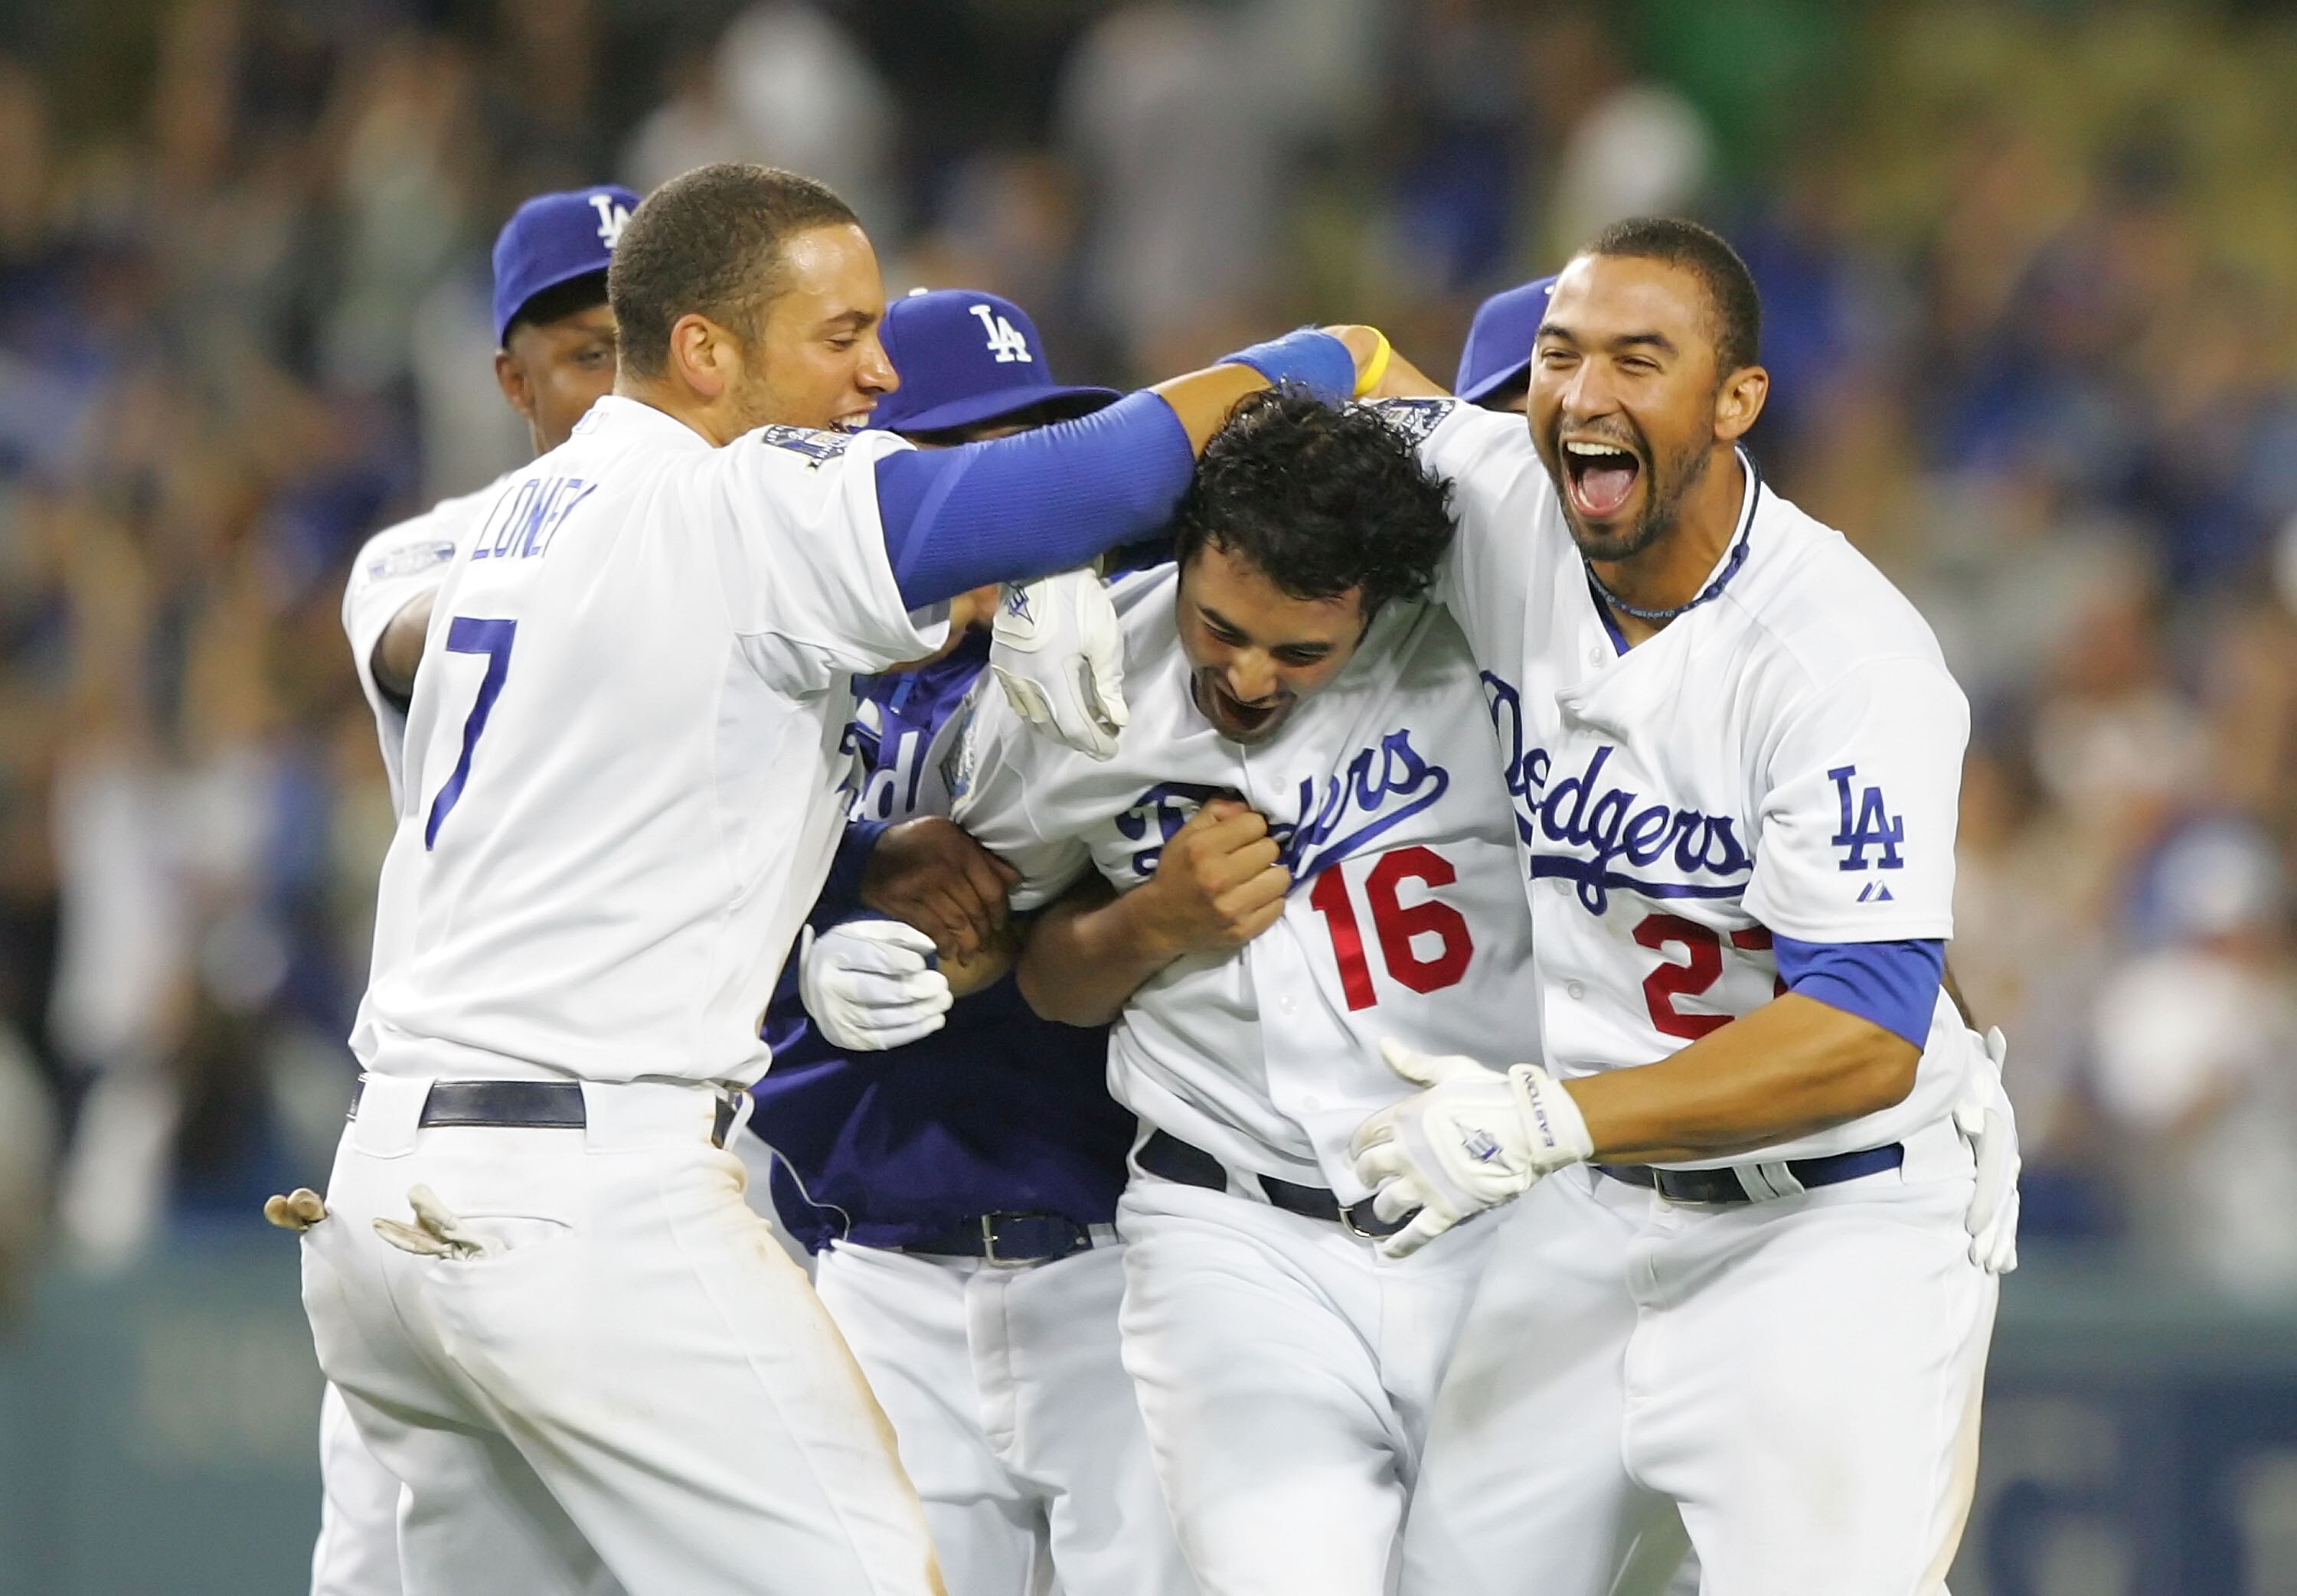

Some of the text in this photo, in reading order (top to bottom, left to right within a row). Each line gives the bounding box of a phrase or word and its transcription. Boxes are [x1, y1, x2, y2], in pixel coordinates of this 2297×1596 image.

[969, 304, 1032, 363] LA
[470, 477, 598, 561] LONEY
[424, 615, 518, 852] 7
[1828, 765, 1904, 870] LA
[1309, 845, 1473, 1012] 16
[1632, 913, 1789, 1040] 2
[1521, 1072, 1555, 1147] EASTON
